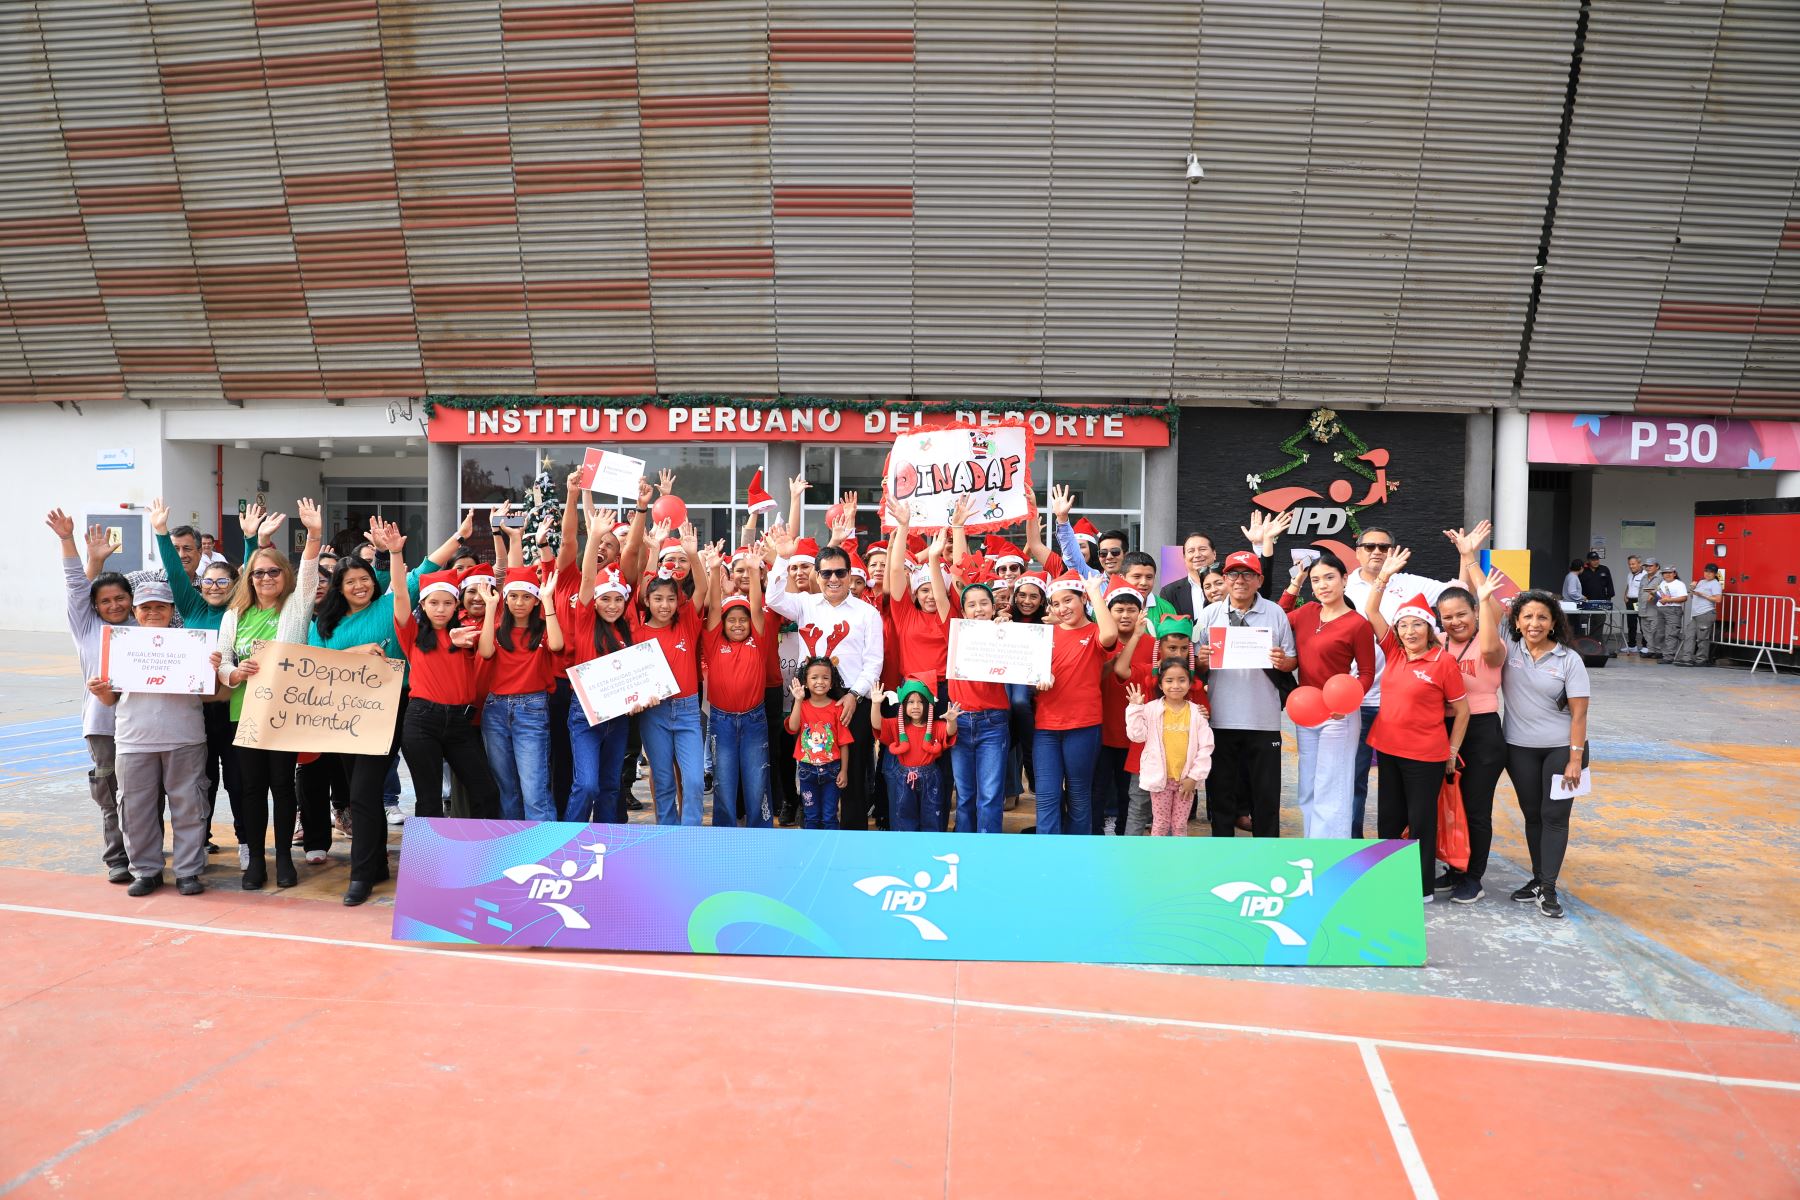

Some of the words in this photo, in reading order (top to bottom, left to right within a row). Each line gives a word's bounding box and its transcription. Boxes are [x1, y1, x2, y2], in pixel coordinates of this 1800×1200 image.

[467, 408, 648, 435] INSTITUTO
[668, 407, 842, 433] PERUANO
[1630, 421, 1658, 461] P
[1664, 422, 1718, 464] 30
[893, 454, 1021, 501] DINADAF
[1287, 507, 1347, 536] IPD
[146, 677, 165, 685] IPD
[298, 657, 382, 689] Deporte
[989, 667, 1006, 676] IPD
[254, 685, 274, 701] es
[337, 694, 385, 712] física
[625, 694, 639, 705] IPD
[269, 710, 287, 730] y
[295, 713, 362, 738] mental
[528, 879, 573, 900] IPD
[881, 890, 927, 912] IPD
[1240, 896, 1285, 917] IPD
